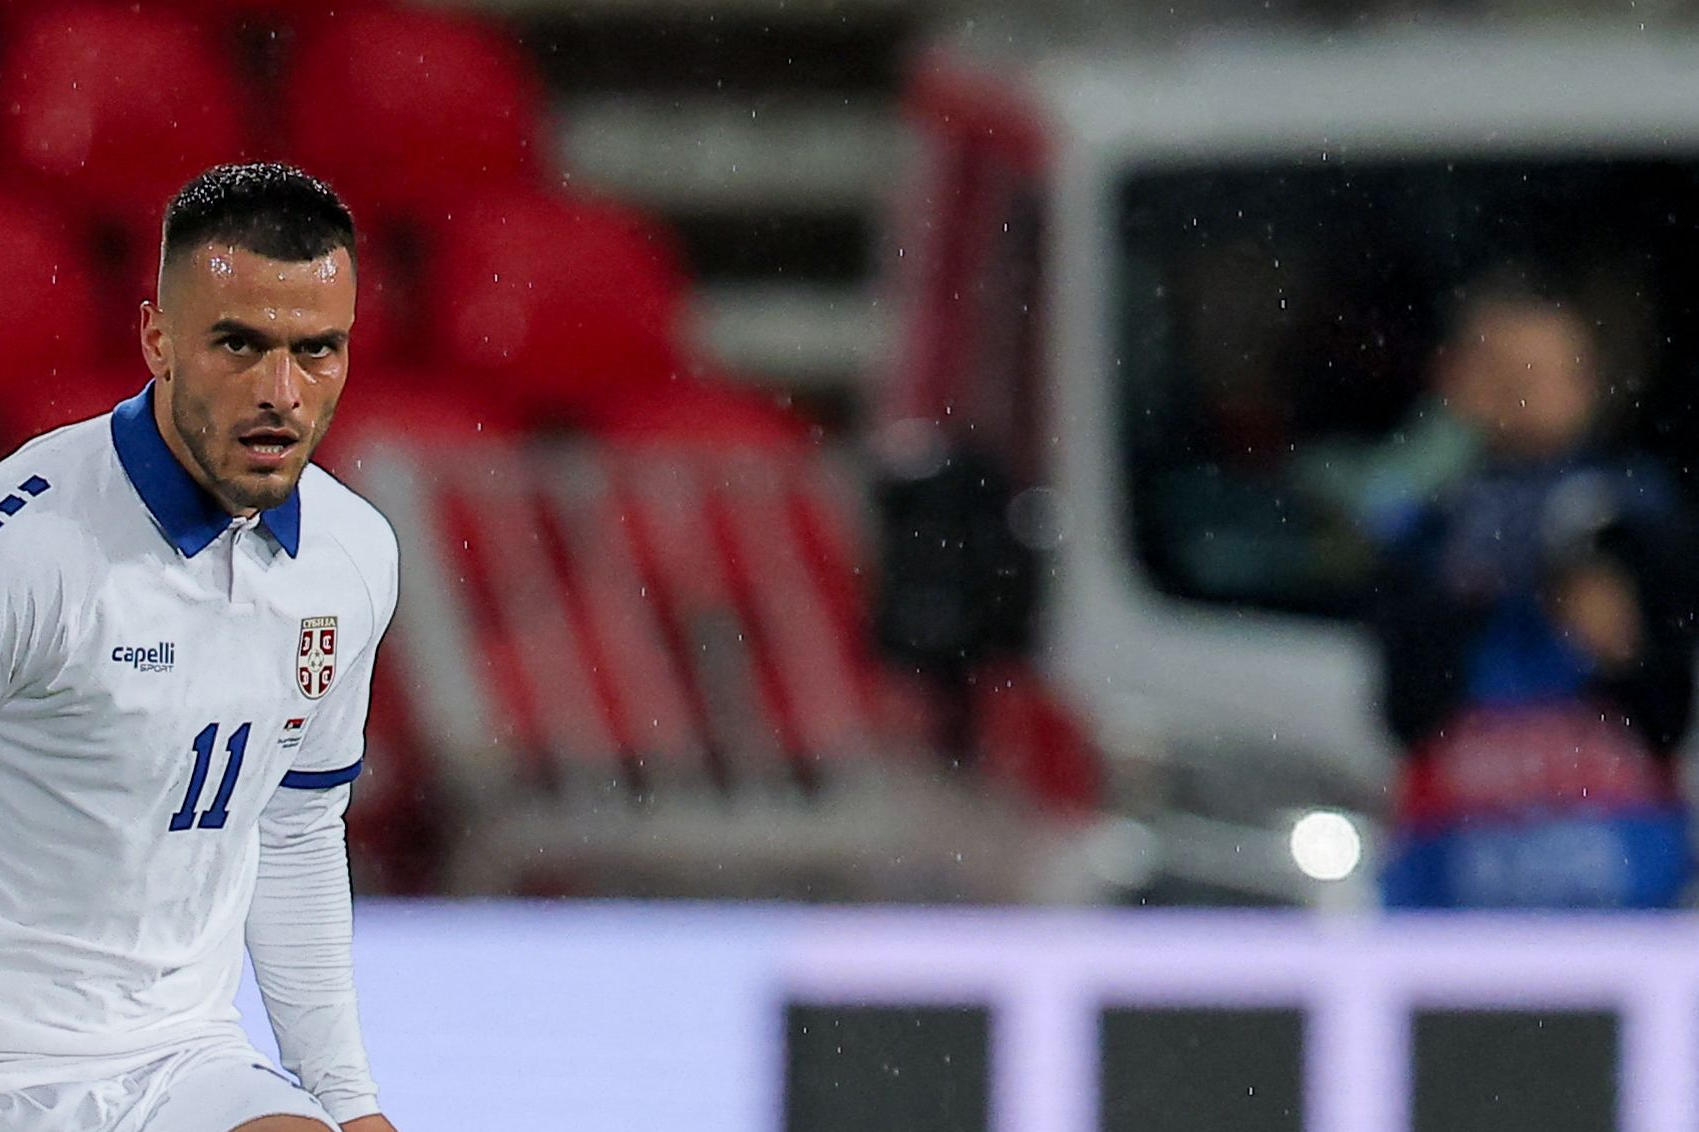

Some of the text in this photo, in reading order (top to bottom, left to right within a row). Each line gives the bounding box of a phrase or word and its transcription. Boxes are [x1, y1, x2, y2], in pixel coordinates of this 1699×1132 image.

[112, 642, 175, 669] capelli
[140, 663, 174, 673] SPORT
[168, 722, 252, 832] 11
